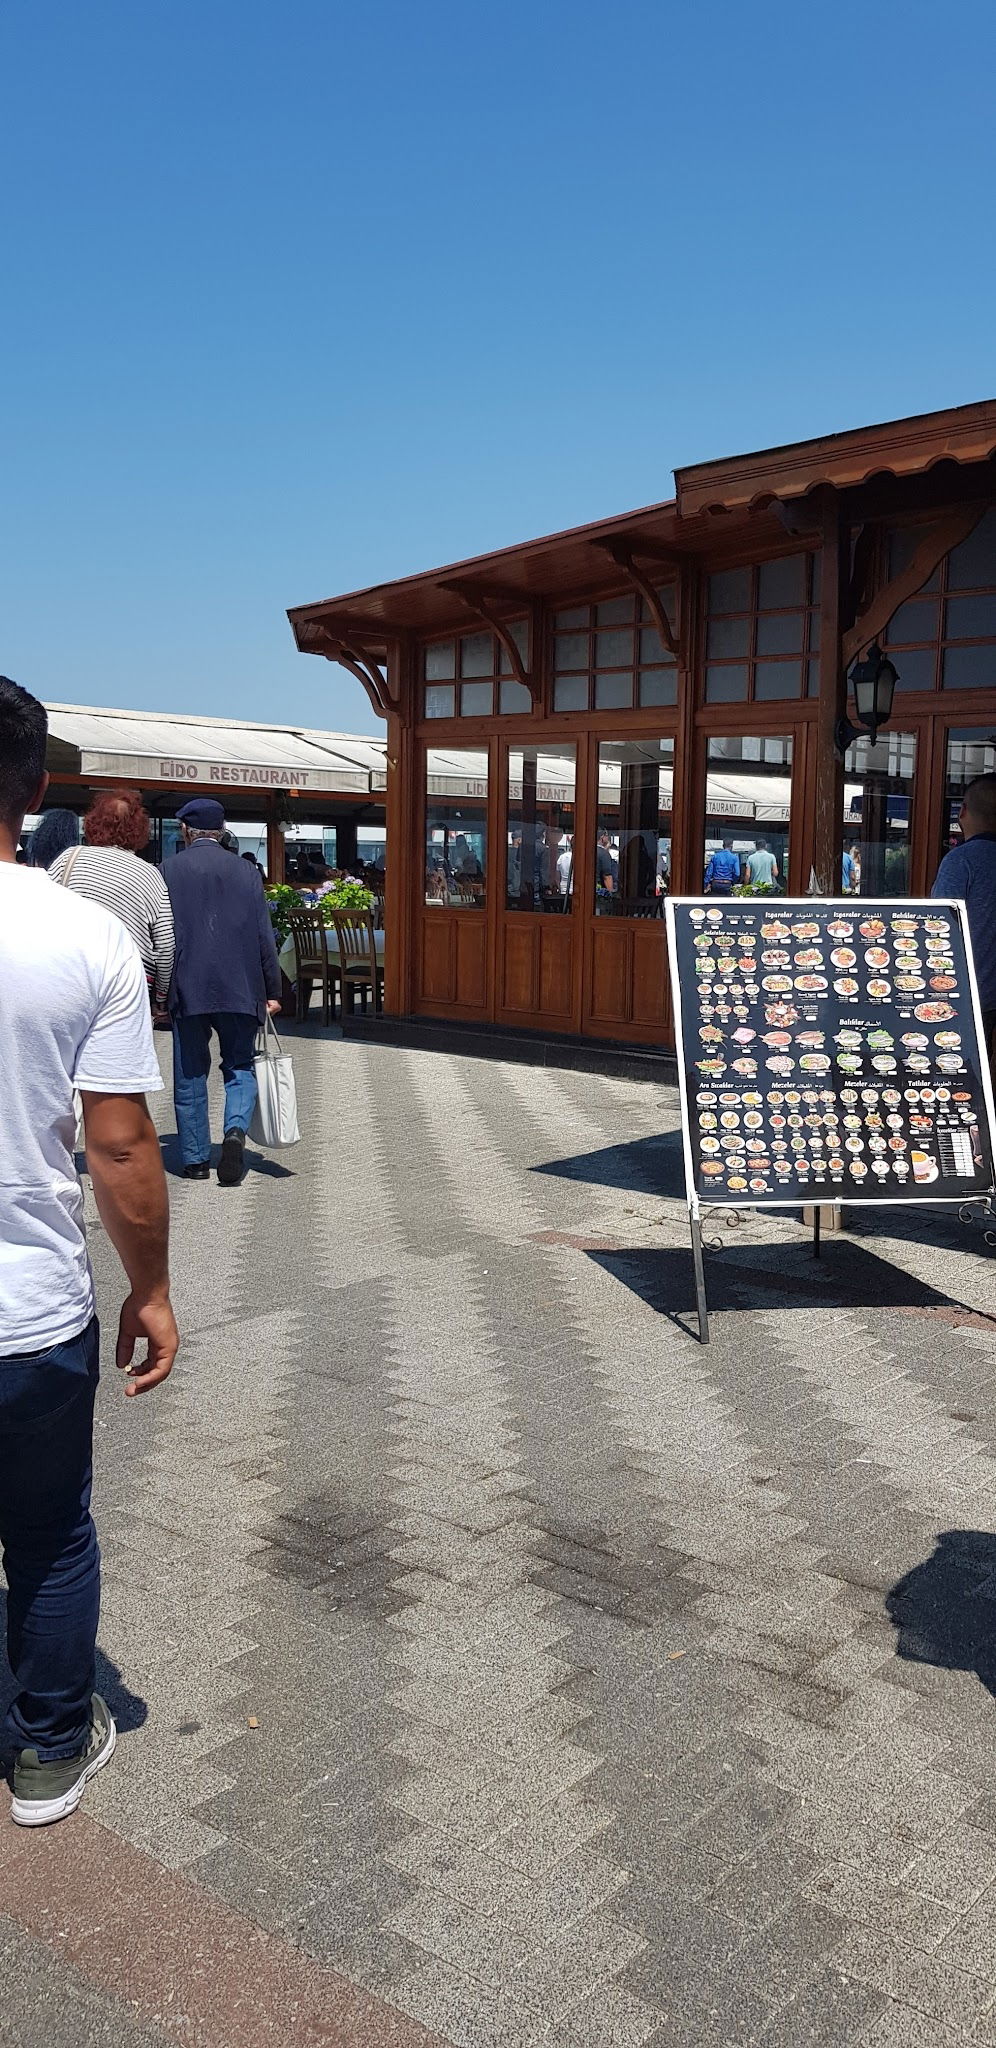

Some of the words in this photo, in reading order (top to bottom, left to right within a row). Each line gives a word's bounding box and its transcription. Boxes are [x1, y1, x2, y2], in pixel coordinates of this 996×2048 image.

[160, 761, 198, 779] LİDO
[210, 766, 309, 786] RESTAURANT
[706, 801, 737, 814] STAURANT
